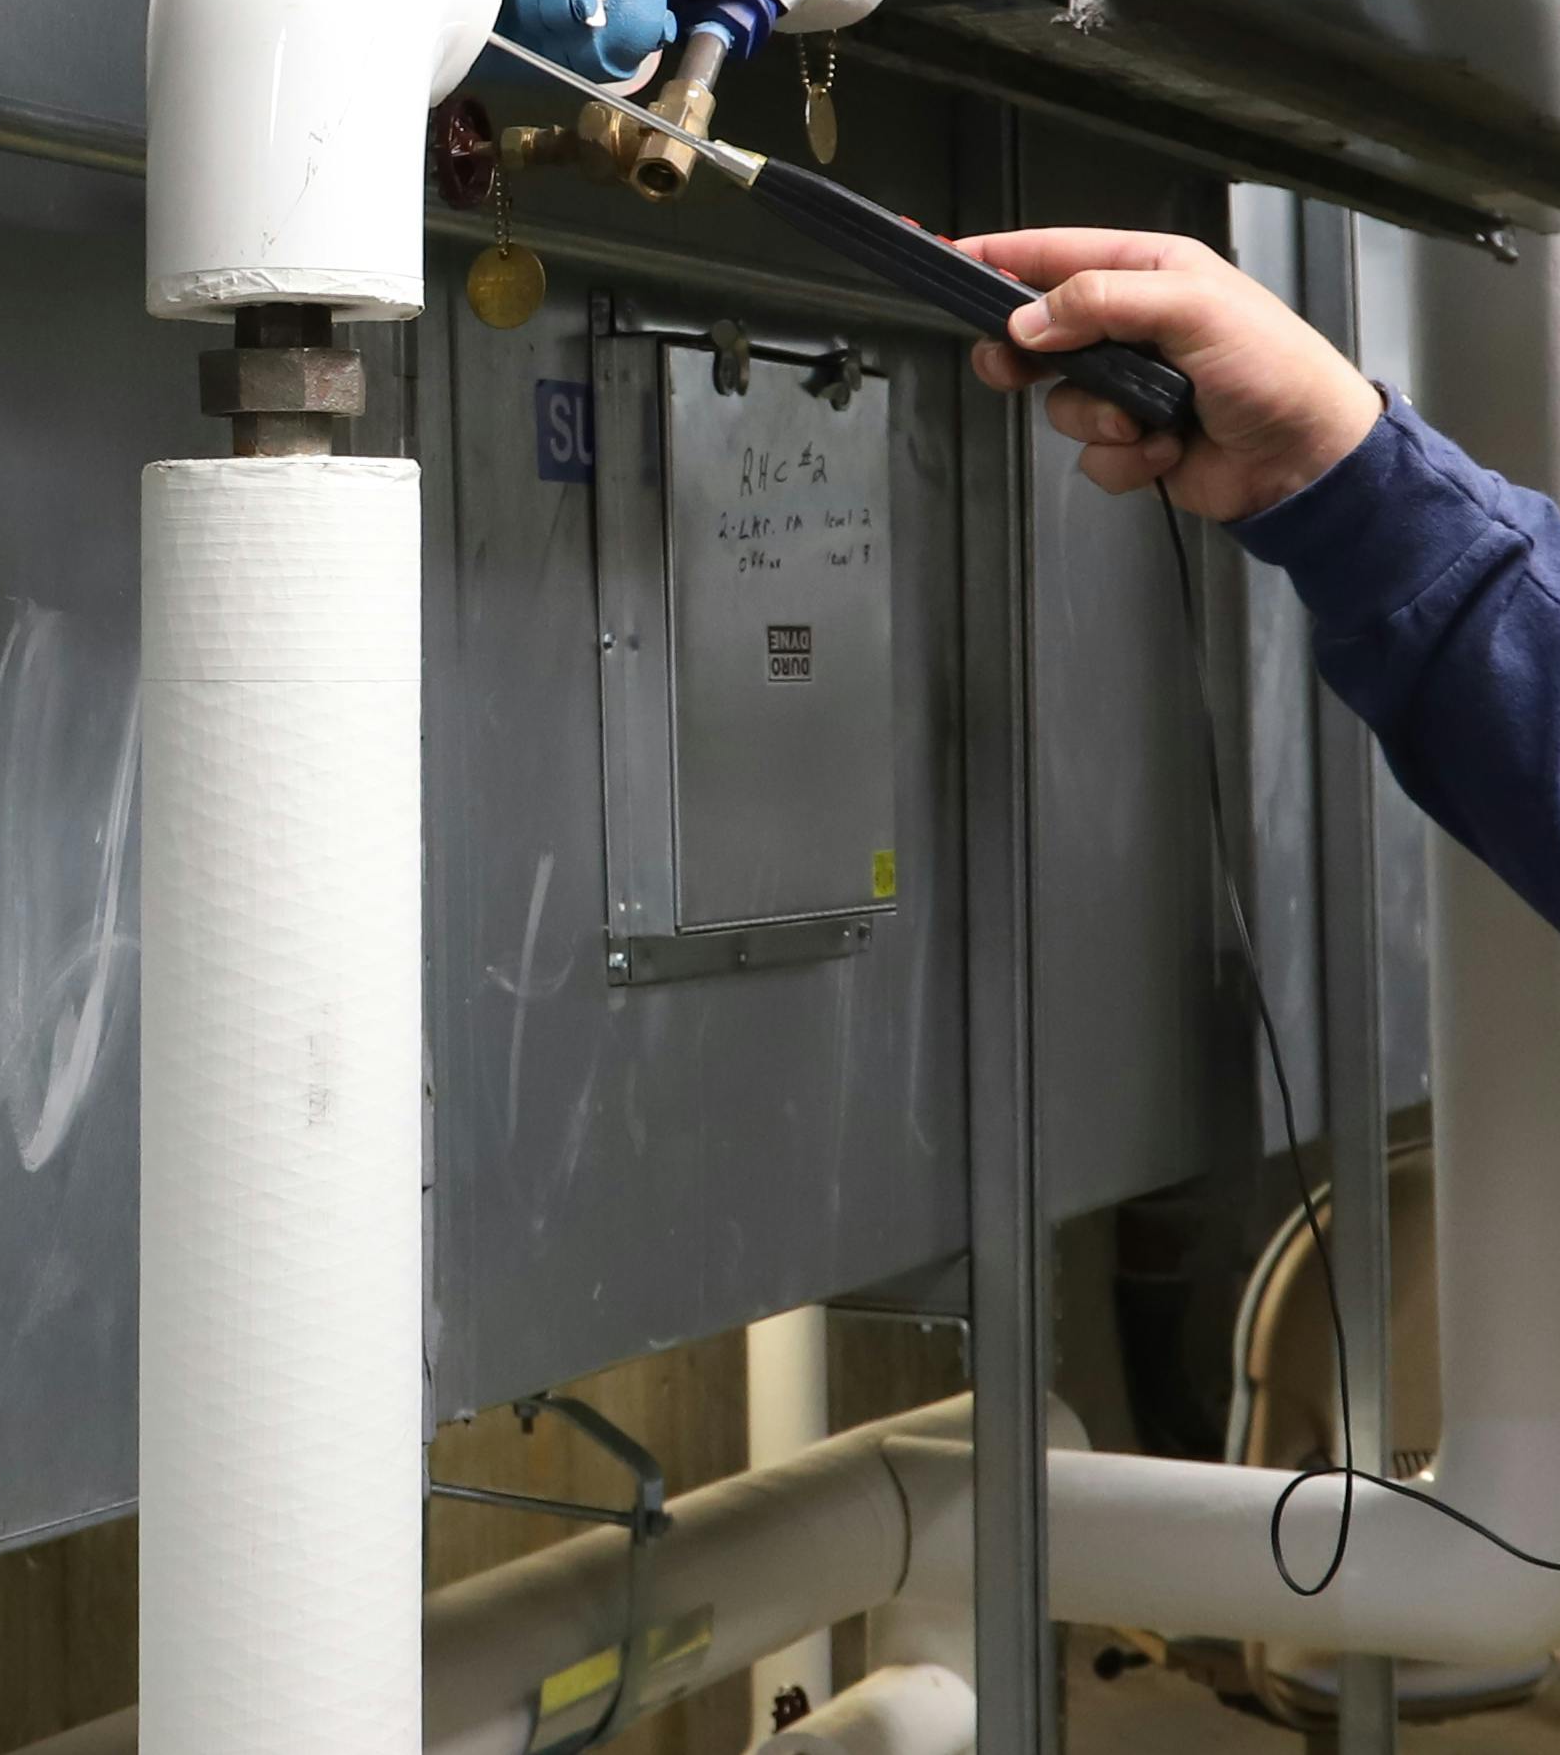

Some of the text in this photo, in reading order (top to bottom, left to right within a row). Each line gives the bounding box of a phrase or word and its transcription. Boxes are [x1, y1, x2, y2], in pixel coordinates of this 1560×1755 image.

[741, 447, 788, 496] RHC
[770, 631, 810, 650] DYNE
[771, 657, 810, 676] DURO
